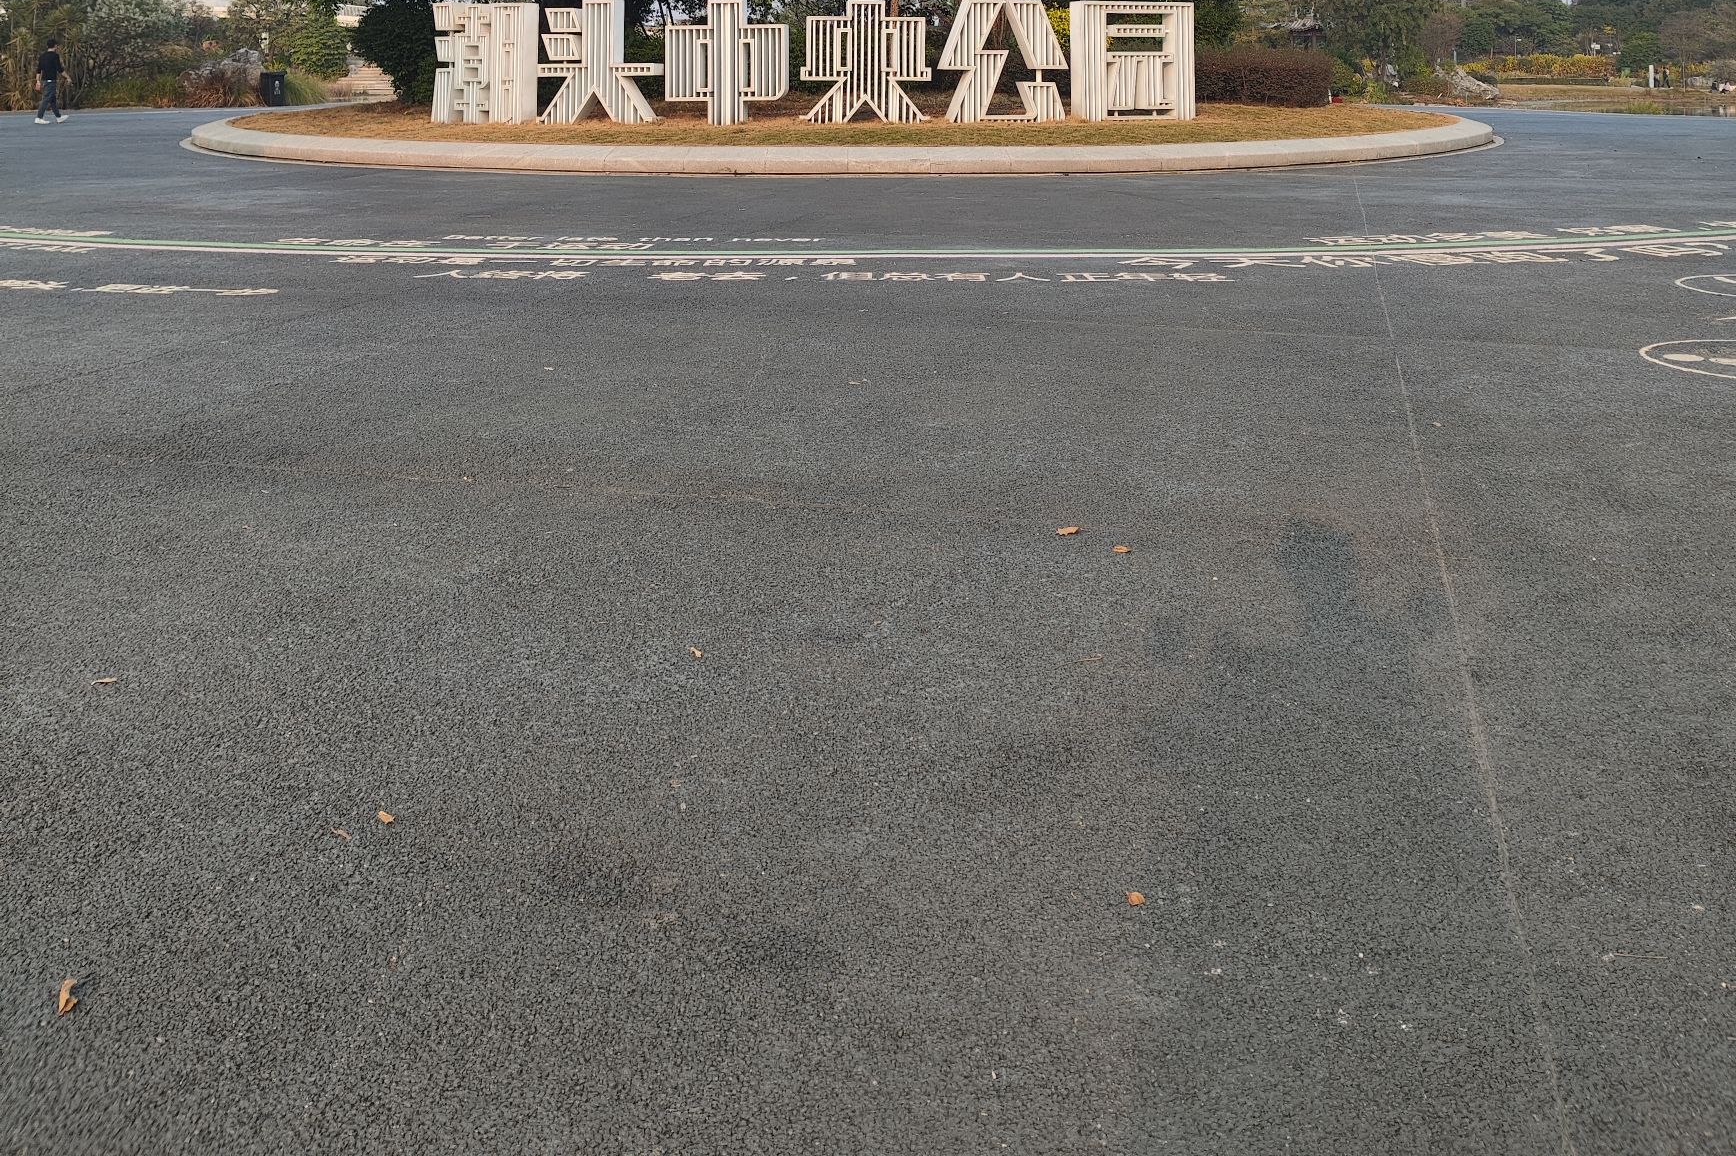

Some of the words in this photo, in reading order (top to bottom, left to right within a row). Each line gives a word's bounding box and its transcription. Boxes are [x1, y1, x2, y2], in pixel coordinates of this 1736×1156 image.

[264, 237, 654, 250] 生命在于运动
[638, 235, 715, 243] than
[328, 255, 857, 267] 运动是一切生命的源泉
